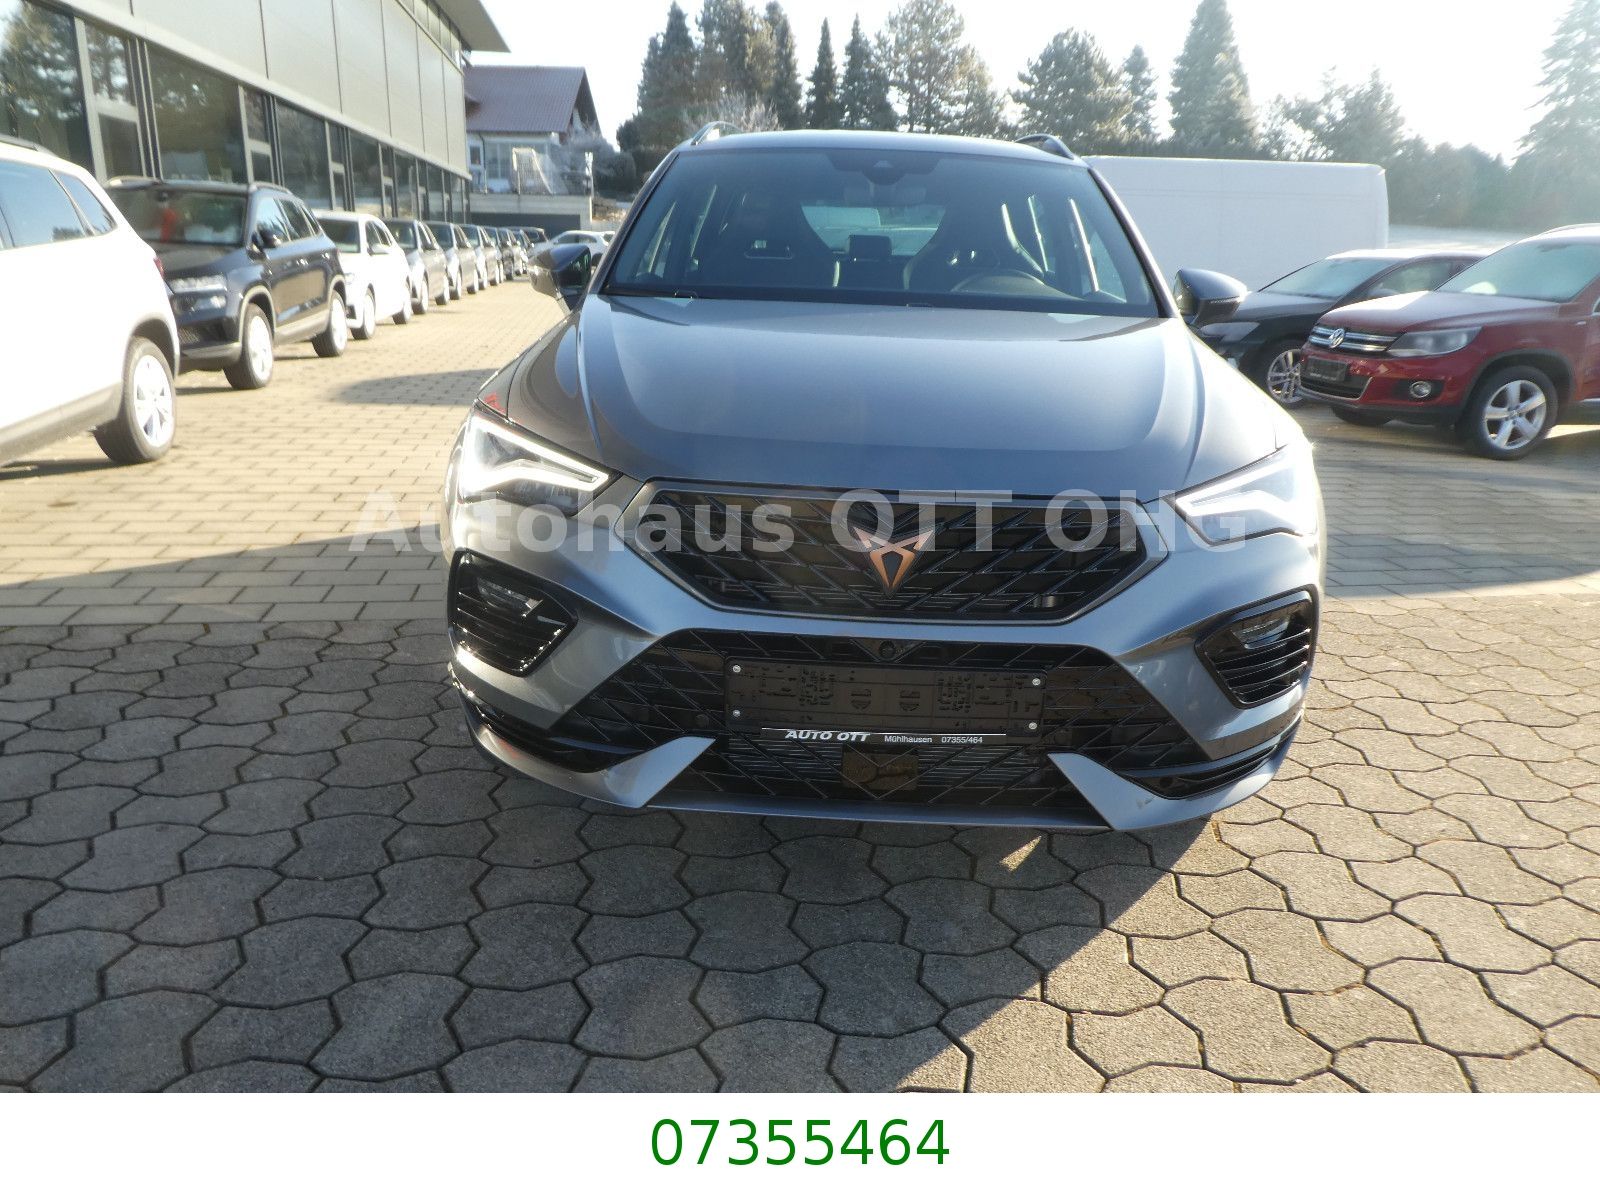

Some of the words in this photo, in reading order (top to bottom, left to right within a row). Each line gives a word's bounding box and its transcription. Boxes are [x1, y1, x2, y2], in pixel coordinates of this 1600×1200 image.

[784, 729, 833, 741] AUTO
[836, 731, 871, 742] OTT
[884, 734, 933, 743] Mühlhausen
[941, 735, 984, 744] 07355/464
